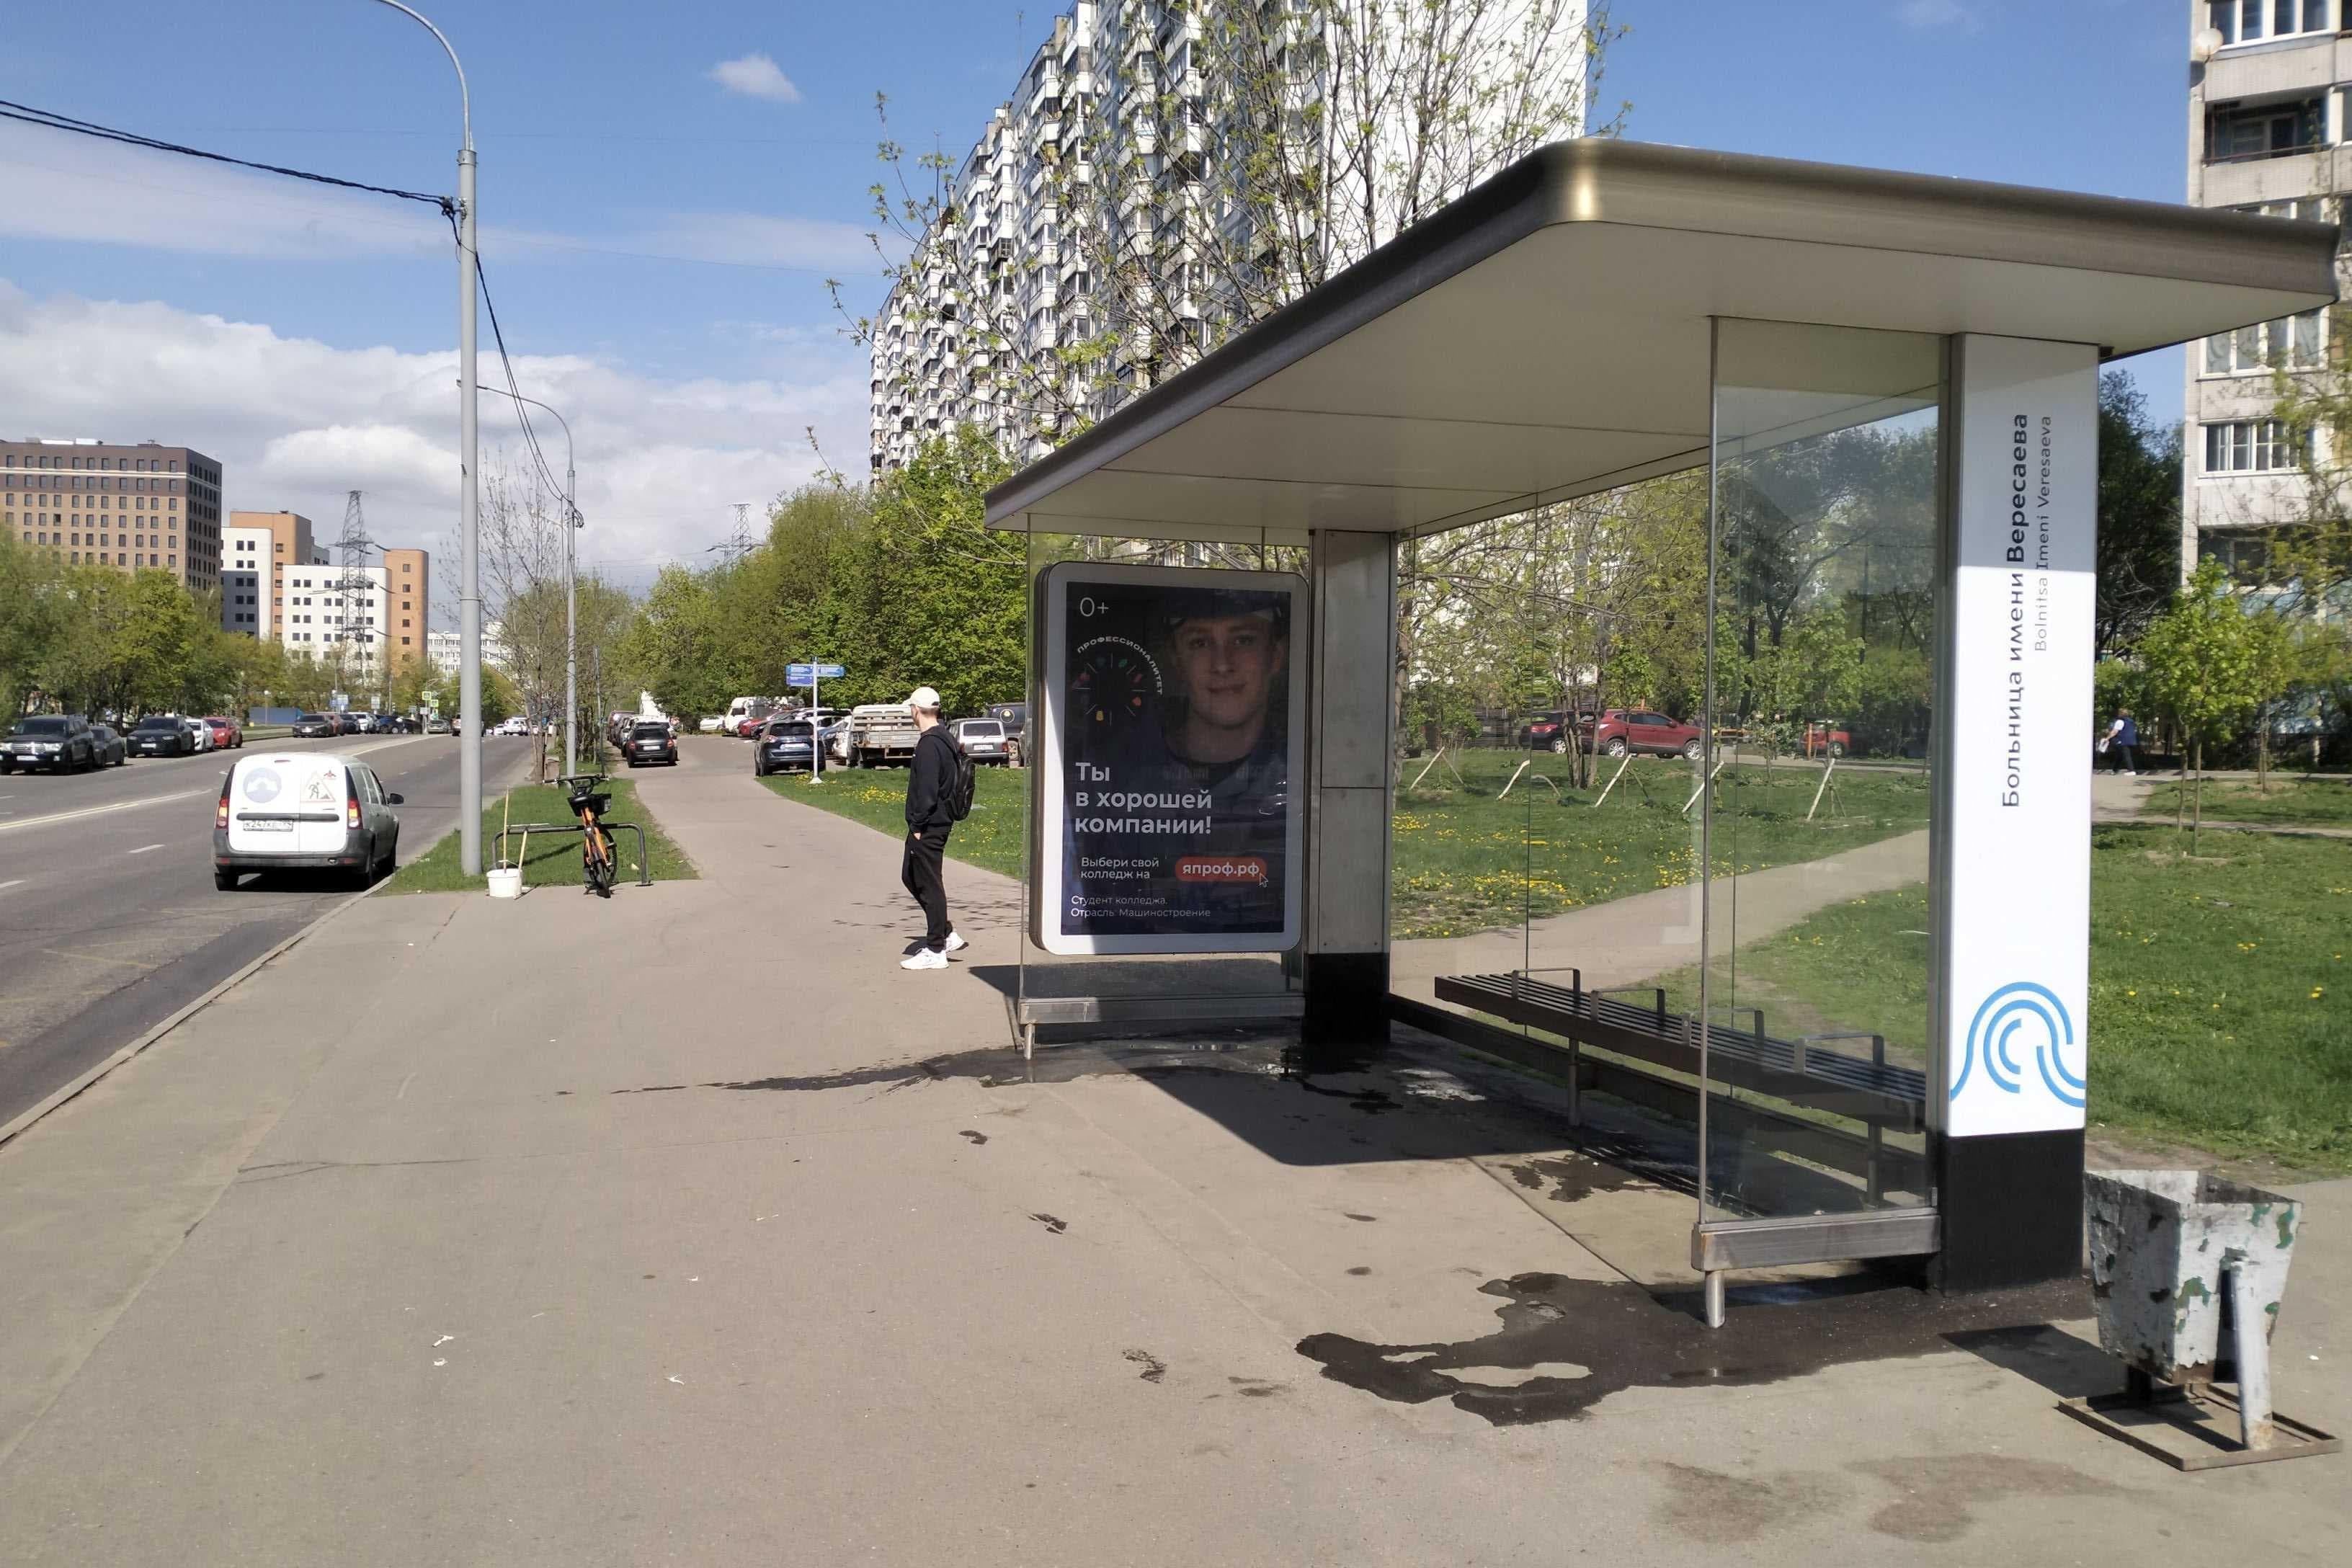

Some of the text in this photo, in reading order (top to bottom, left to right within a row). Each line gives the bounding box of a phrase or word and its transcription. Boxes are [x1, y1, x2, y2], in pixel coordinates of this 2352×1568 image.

[2034, 416, 2052, 651] Bolnitsa Imeni Veresaeva
[1079, 597, 1110, 617] 0+
[2003, 414, 2029, 807] Больница имени Вересаева
[1077, 636, 1163, 695] ПРОФЕССИОНАЛИТЕТ
[1075, 762, 1110, 782] Ты
[1076, 788, 1212, 812] в хорошей
[1075, 815, 1211, 834] компании!
[1081, 855, 1159, 871] Выбери свой
[1182, 861, 1260, 877] япроф.рф
[1081, 870, 1133, 879] колледж
[1071, 895, 1113, 906] Студент
[1119, 909, 1211, 917] Машиностроение
